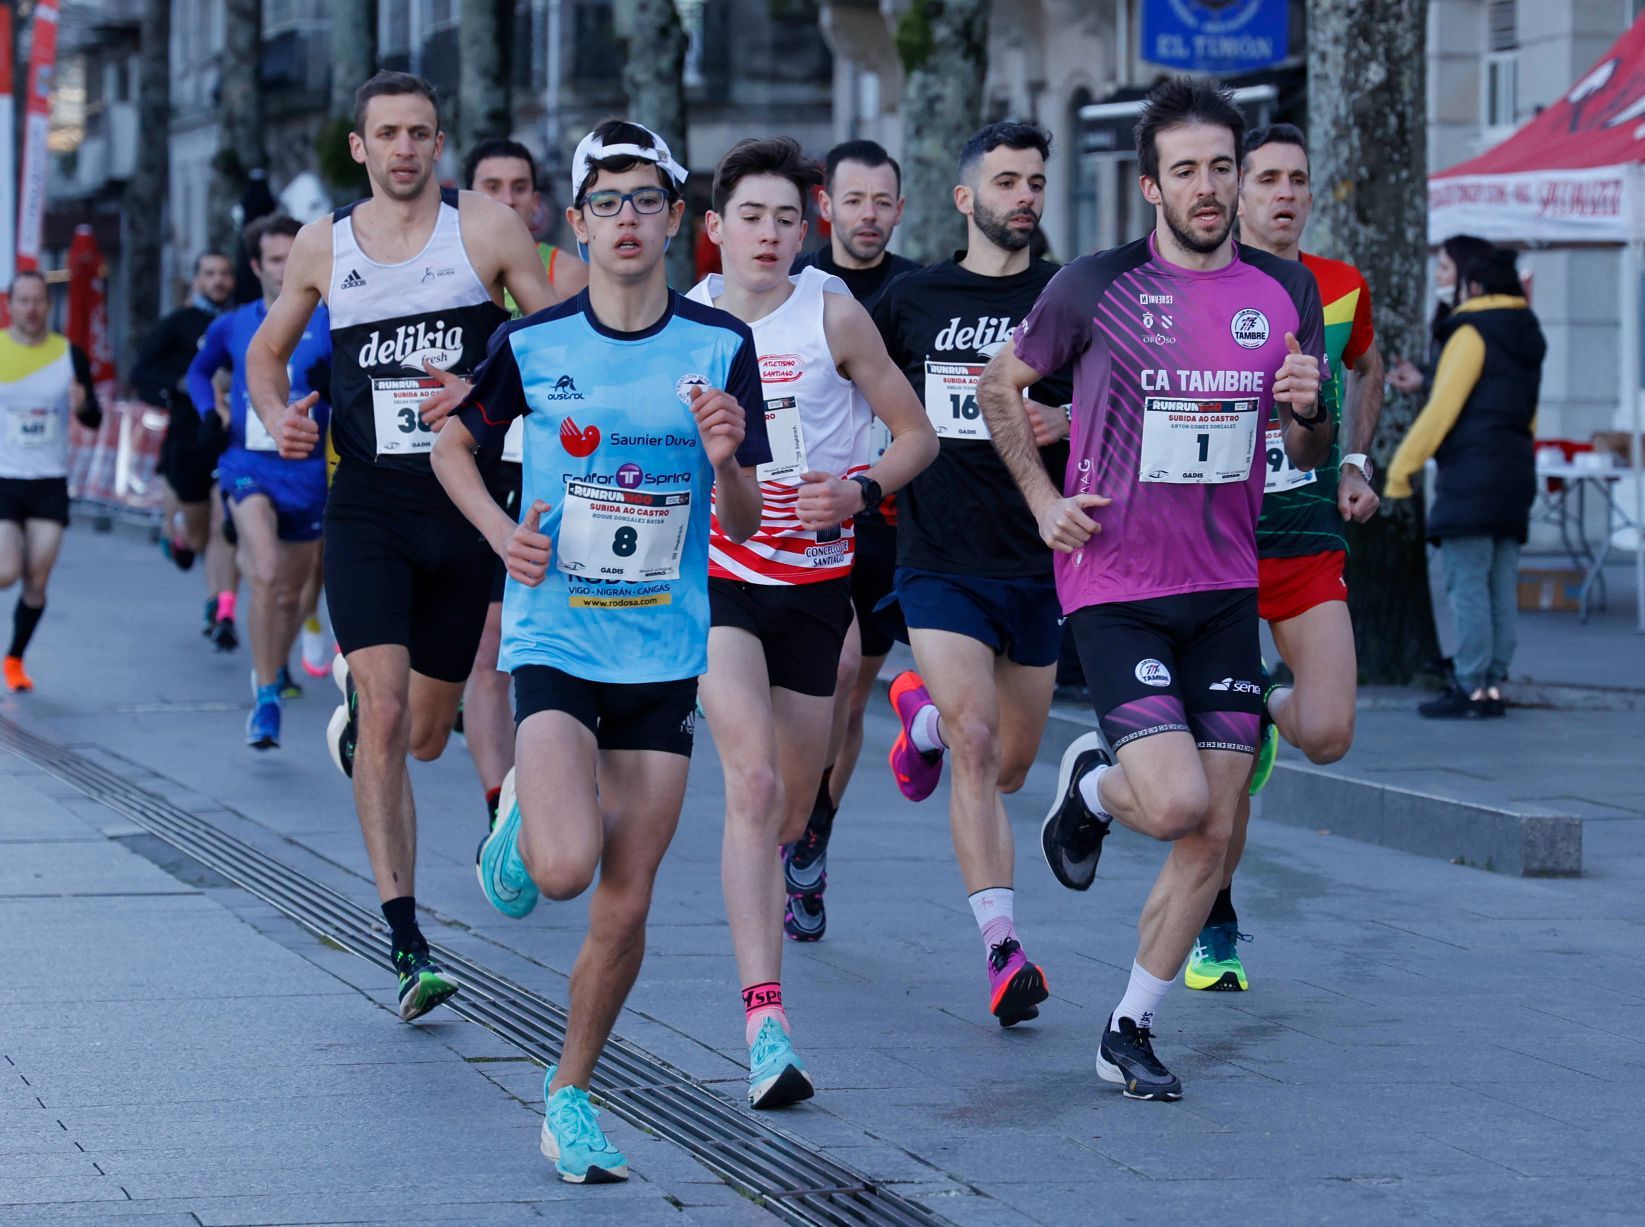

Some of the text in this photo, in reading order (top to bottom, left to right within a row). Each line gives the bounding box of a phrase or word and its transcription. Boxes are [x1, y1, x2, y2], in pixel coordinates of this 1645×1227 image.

[341, 280, 367, 290] adidas
[1235, 331, 1266, 340] TAMBRE
[1140, 369, 1264, 392] CA TAMBRE
[1168, 414, 1240, 423] SUBIDA AO CASTRO
[610, 434, 664, 447] Saunier
[1196, 433, 1210, 462] 1
[590, 503, 620, 513] SUBIDA
[636, 508, 670, 517] CASTRO
[612, 526, 638, 557] 8
[600, 567, 624, 575] GADIS
[568, 586, 590, 595] VIGO
[596, 586, 632, 596] NIGRÁN
[637, 584, 670, 595] CANGAS
[583, 597, 658, 607] www.rodosa.com
